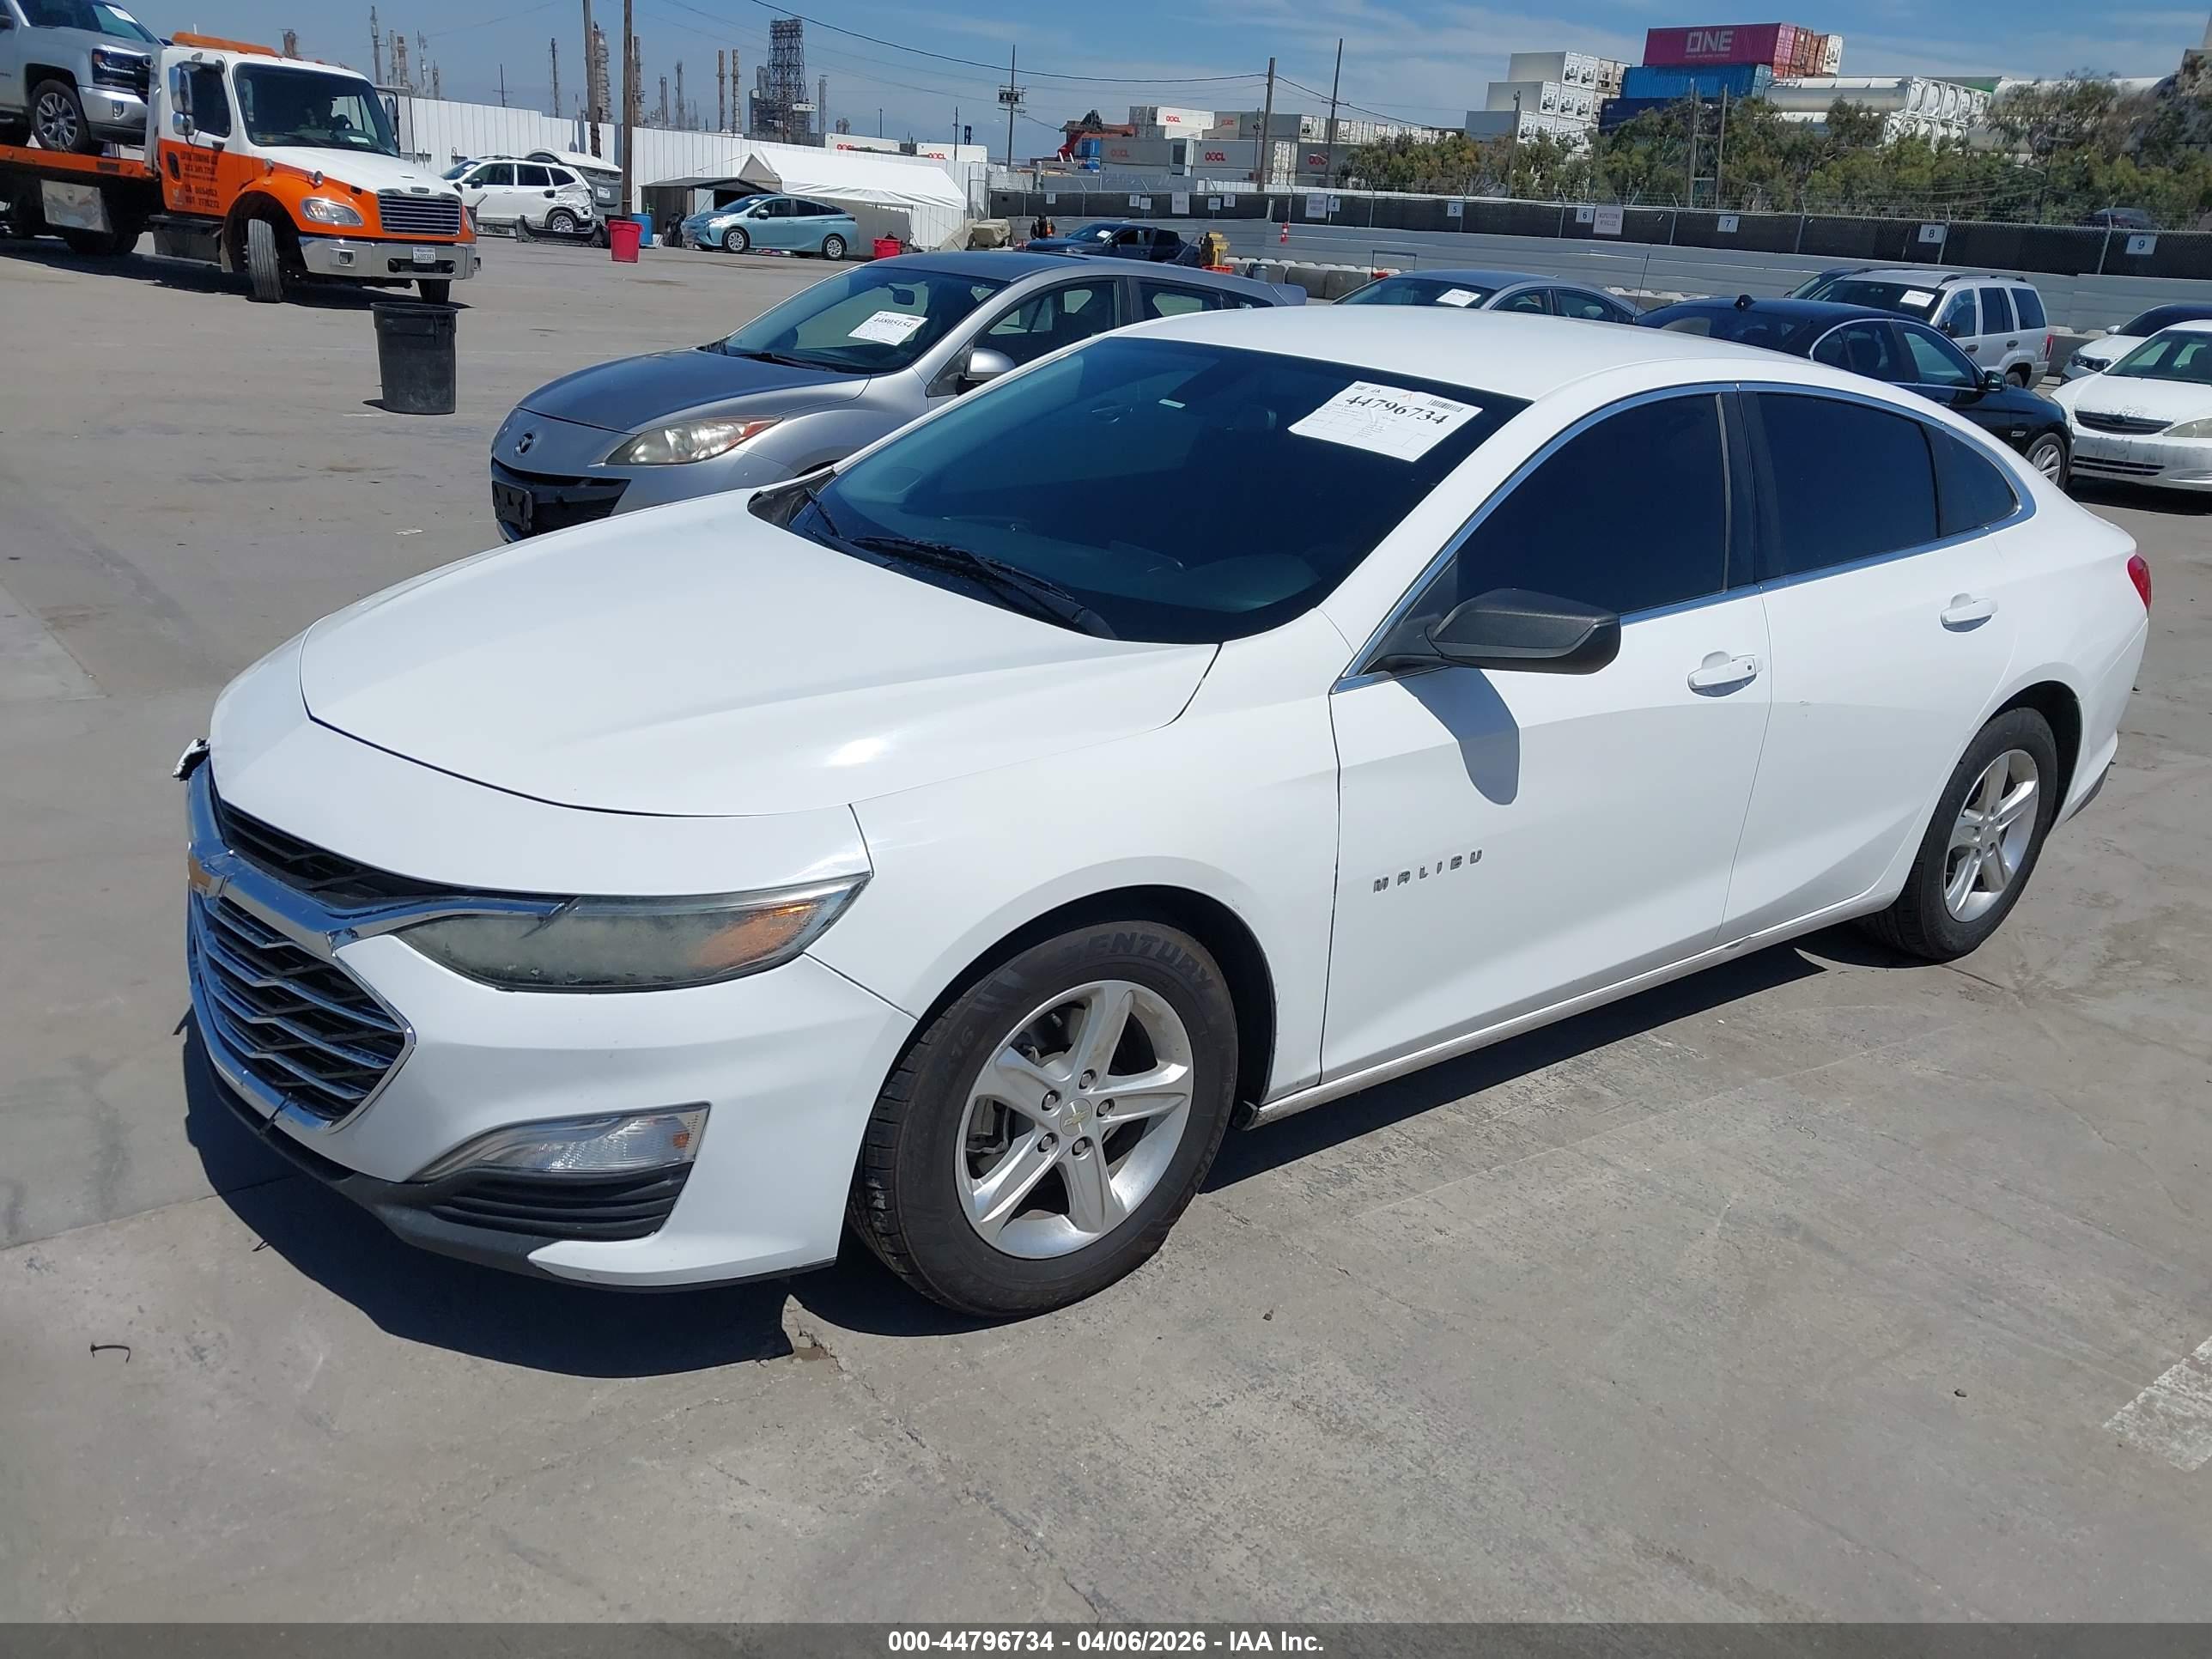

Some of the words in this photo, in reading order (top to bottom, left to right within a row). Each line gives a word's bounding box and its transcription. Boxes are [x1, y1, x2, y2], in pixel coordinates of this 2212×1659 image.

[1686, 31, 1733, 52] ONE
[1205, 151, 1225, 161] OOCL
[1346, 395, 1449, 424] 44796734
[1373, 849, 1482, 893] MALIBU
